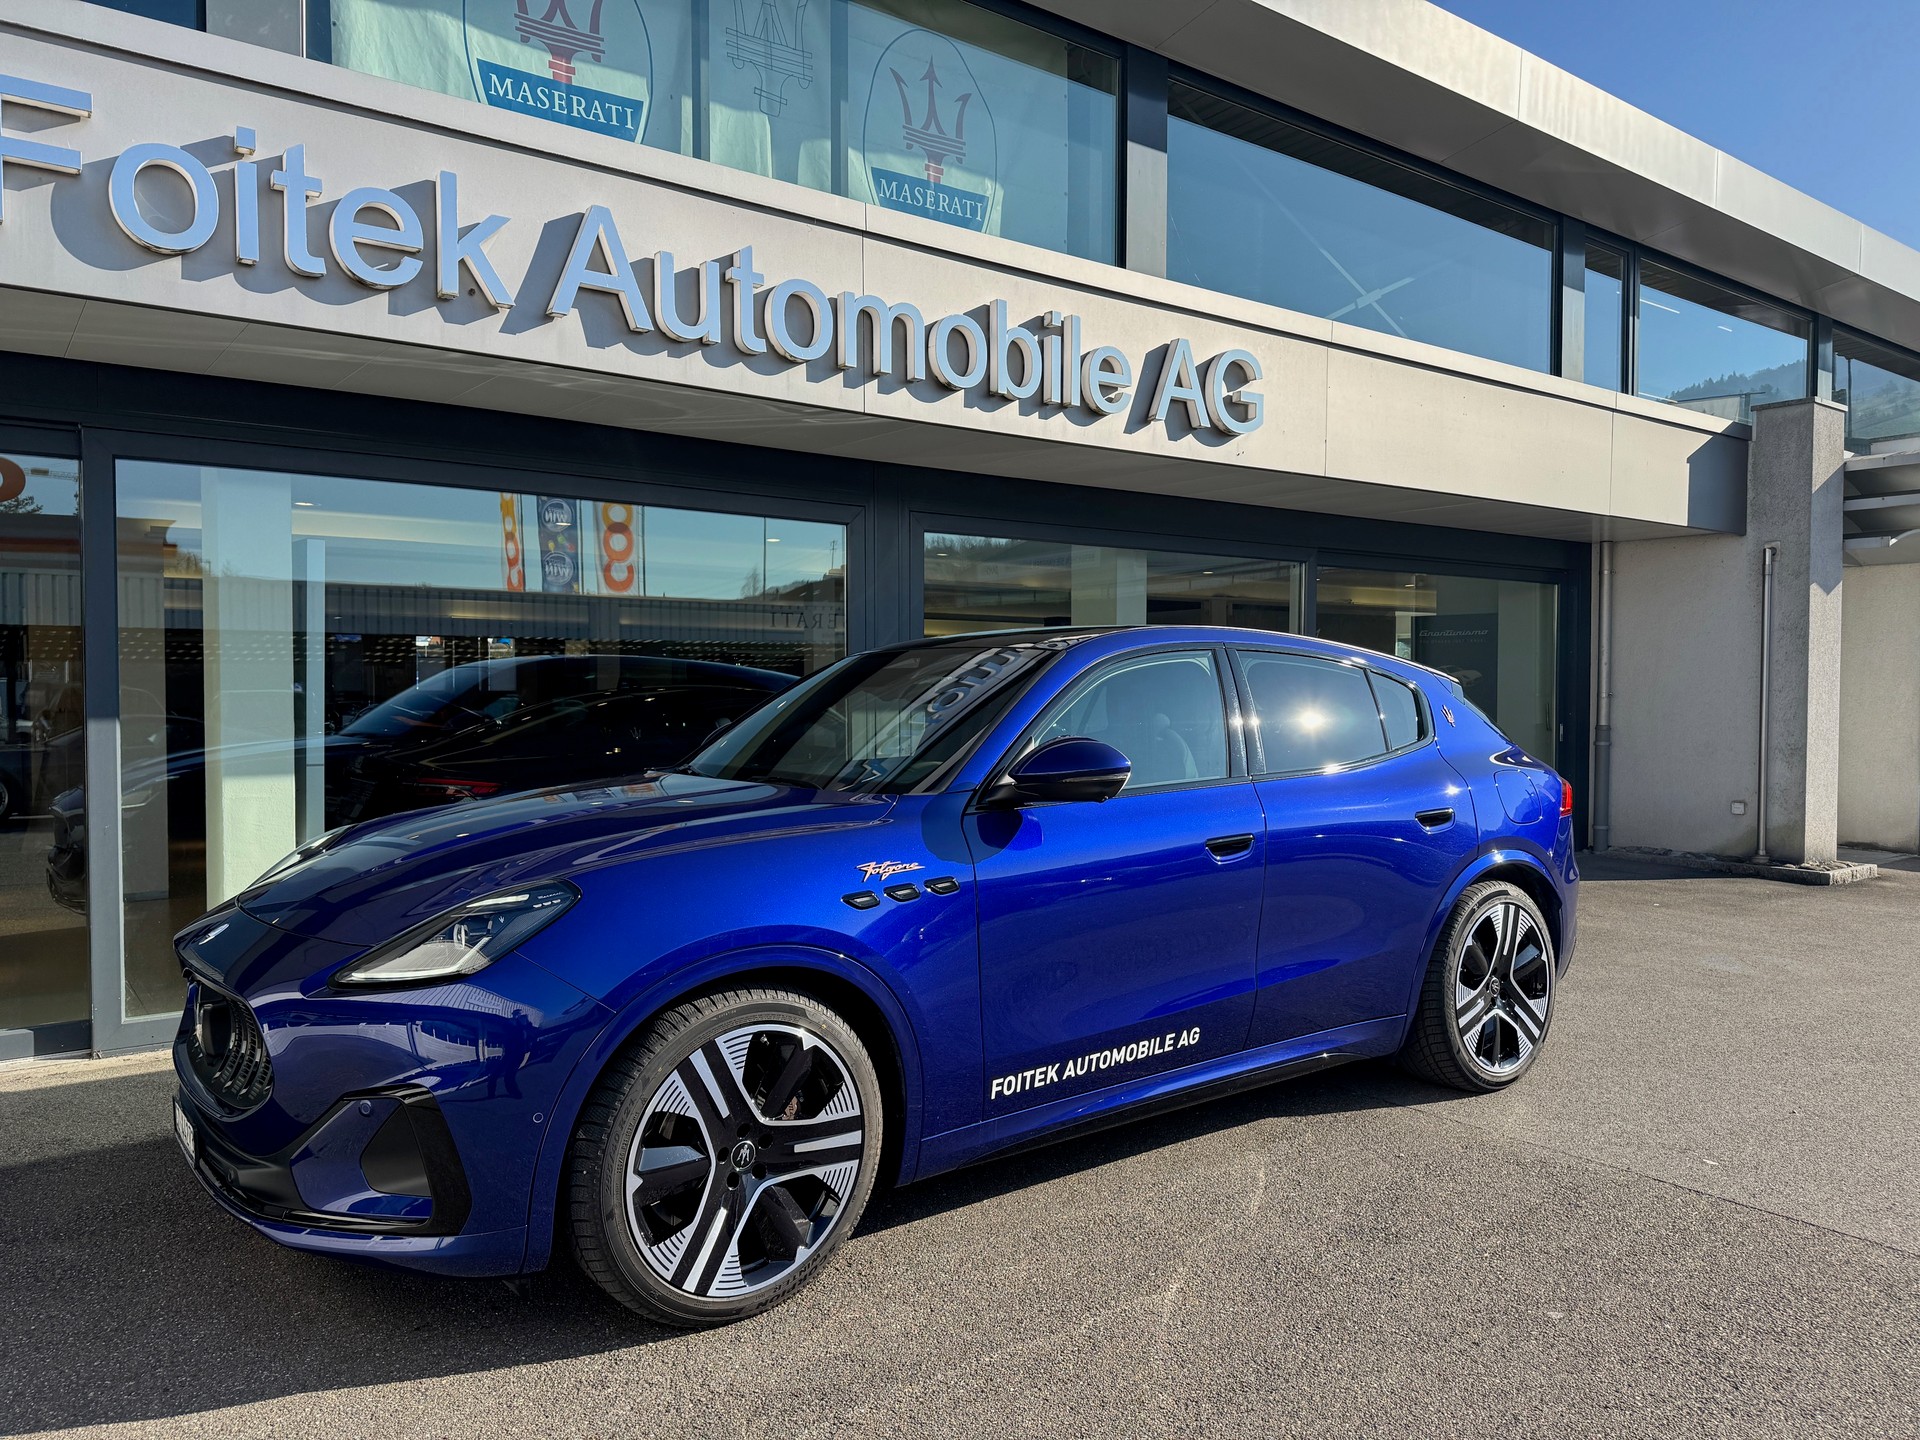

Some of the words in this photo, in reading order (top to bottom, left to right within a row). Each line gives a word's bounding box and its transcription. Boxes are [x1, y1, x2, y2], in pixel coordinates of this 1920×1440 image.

[488, 72, 635, 132] MASERATI
[878, 177, 985, 223] MASERATI
[0, 73, 515, 310] Foitek
[546, 204, 1132, 415] Automobile
[1148, 337, 1265, 437] AG
[856, 861, 926, 883] Folgore
[990, 1063, 1061, 1100] FOITEK
[1062, 1036, 1175, 1081] AUTOMOBILE
[1177, 1027, 1202, 1048] AG
